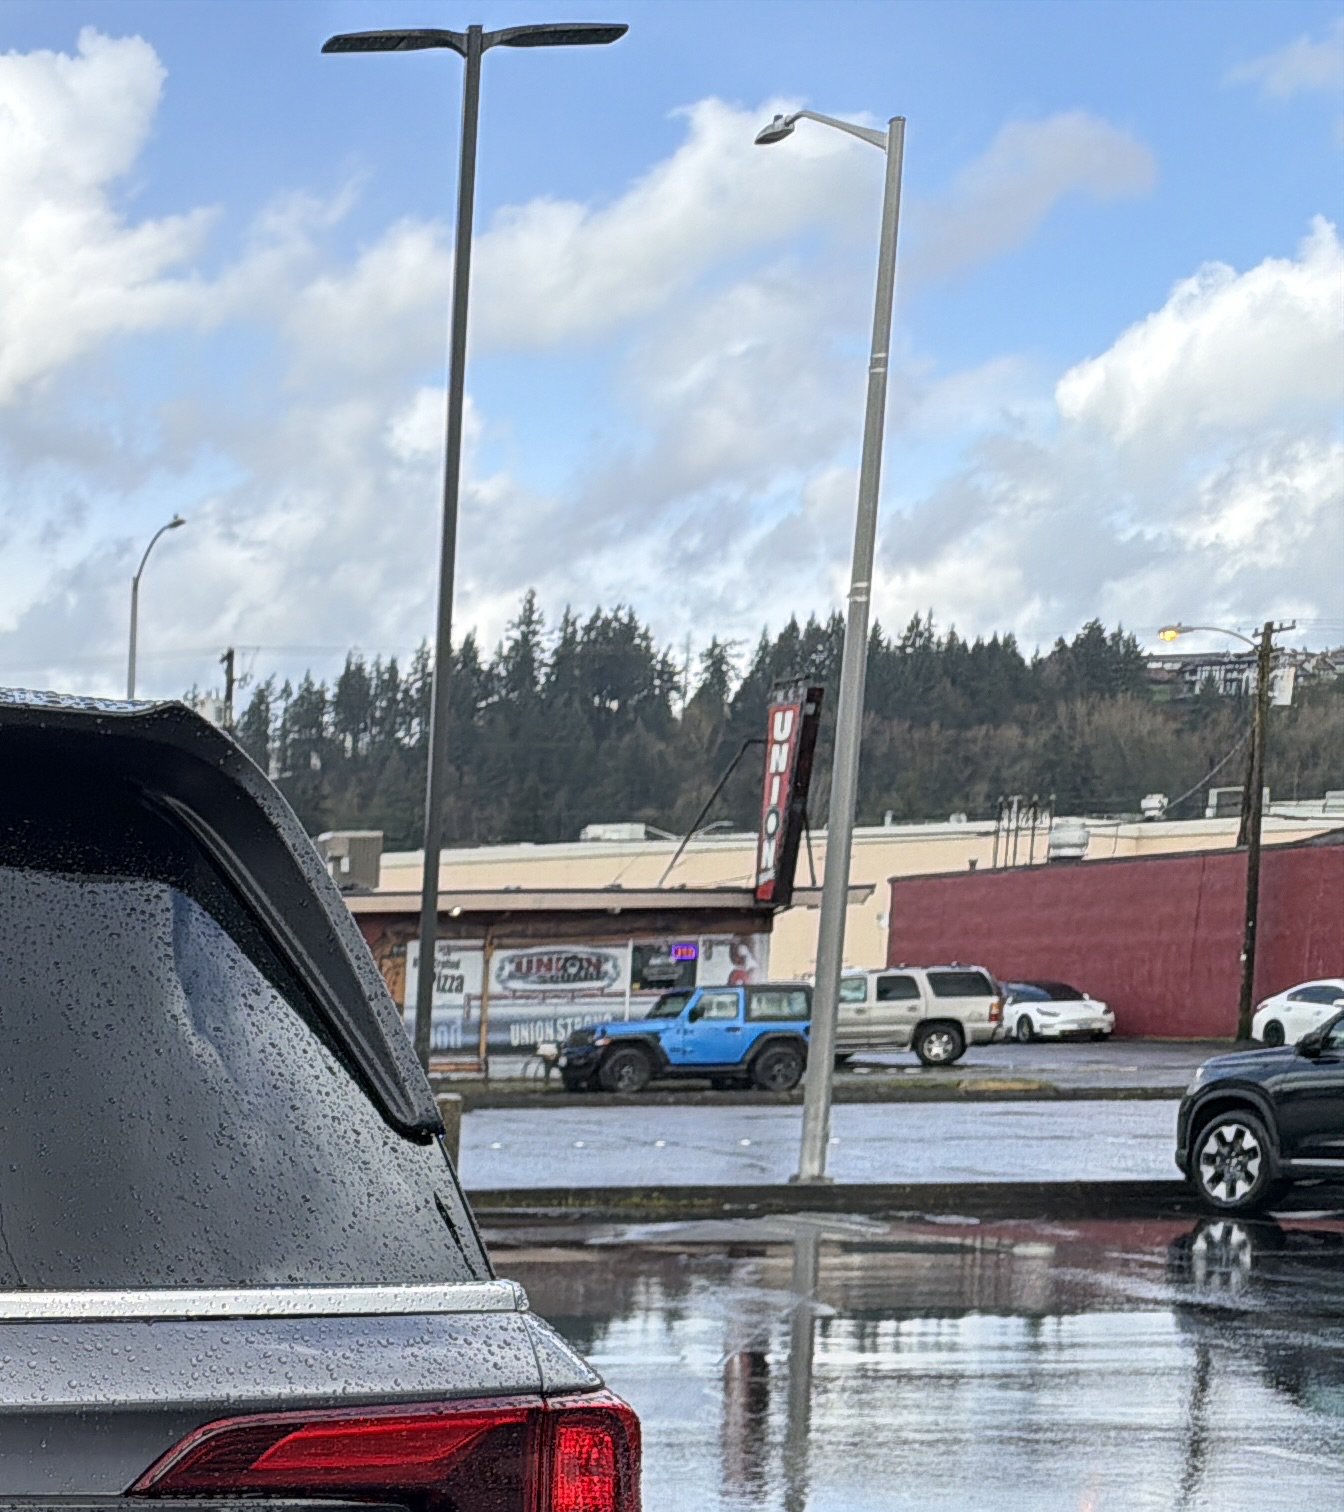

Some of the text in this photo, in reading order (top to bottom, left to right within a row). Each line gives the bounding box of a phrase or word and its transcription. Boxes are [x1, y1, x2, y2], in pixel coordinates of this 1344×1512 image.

[760, 710, 794, 869] UNION
[432, 971, 464, 993] izza
[510, 1018, 554, 1047] UNION
